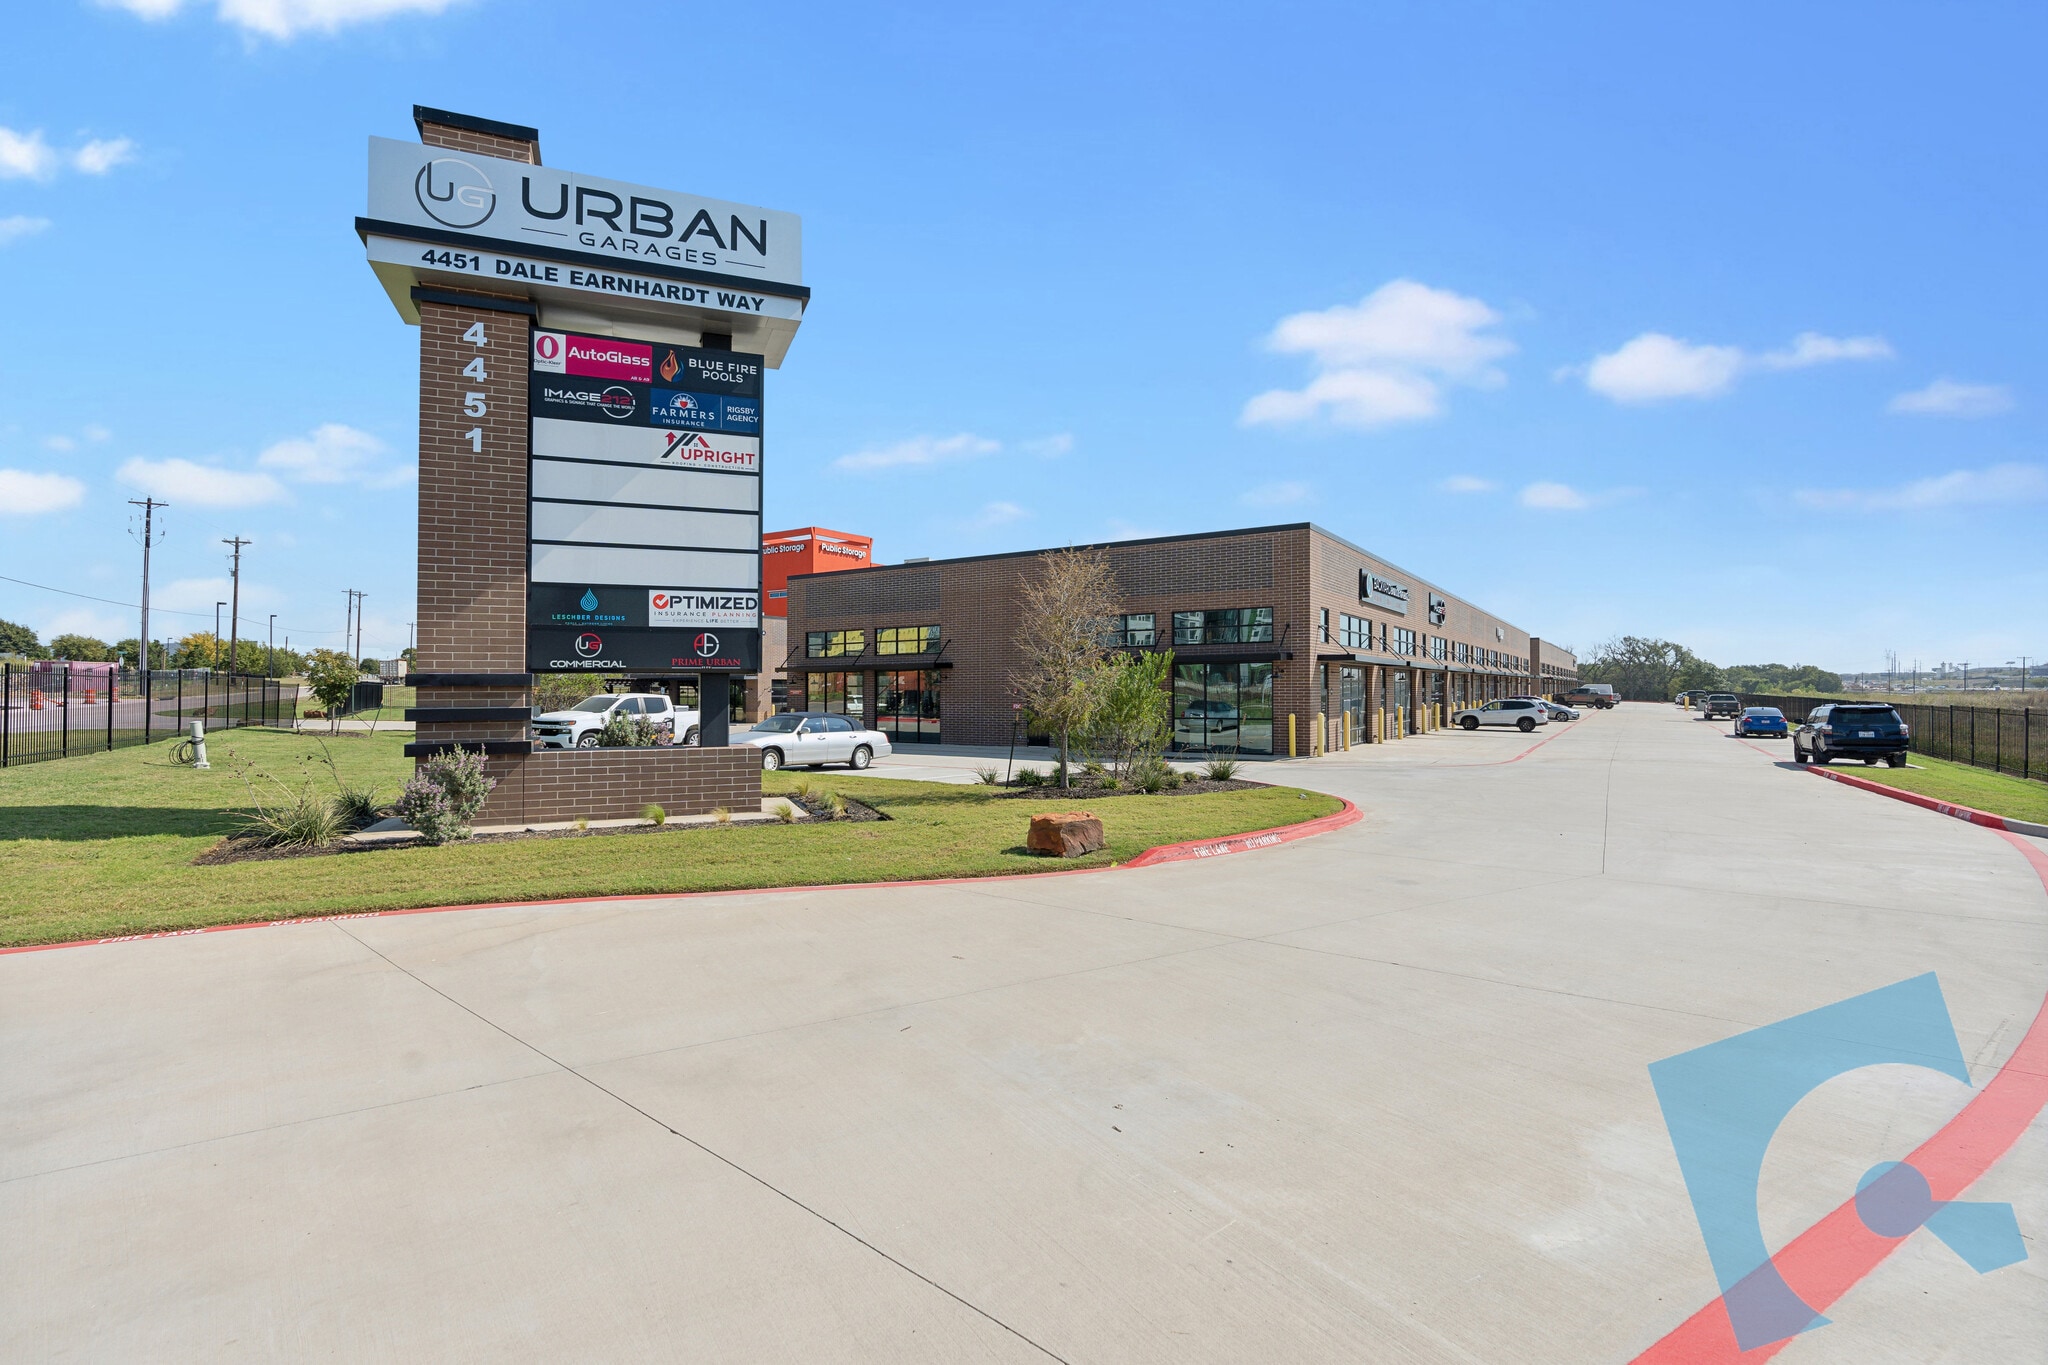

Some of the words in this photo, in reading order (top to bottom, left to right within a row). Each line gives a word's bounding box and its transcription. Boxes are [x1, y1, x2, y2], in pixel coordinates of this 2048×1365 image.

[522, 176, 766, 256] URBAN
[578, 232, 718, 266] GARAGES
[421, 249, 480, 272] 4451
[496, 260, 558, 283] DALE
[570, 270, 710, 304] EARNHARDT
[717, 292, 766, 312] WAY
[568, 346, 650, 366] AutoGlass
[688, 358, 724, 370] BLUE
[728, 363, 757, 374] FIRE
[702, 370, 743, 383] POOLS
[652, 407, 715, 420] FARMERS
[727, 406, 755, 414] RIGSBY
[663, 418, 704, 427] INSURANCE
[727, 414, 758, 423] AGENCY
[681, 448, 755, 464] UPRIGHT
[779, 544, 805, 553] Storage
[821, 542, 841, 554] Public
[842, 546, 866, 558] Storage
[1192, 846, 1211, 858] FIRE
[1210, 843, 1231, 856] LANE
[1245, 838, 1255, 849] NO
[1254, 833, 1282, 847] PARKING
[300, 912, 380, 924] PARKING
[98, 934, 146, 944] FIRE
[152, 929, 208, 938] LANE
